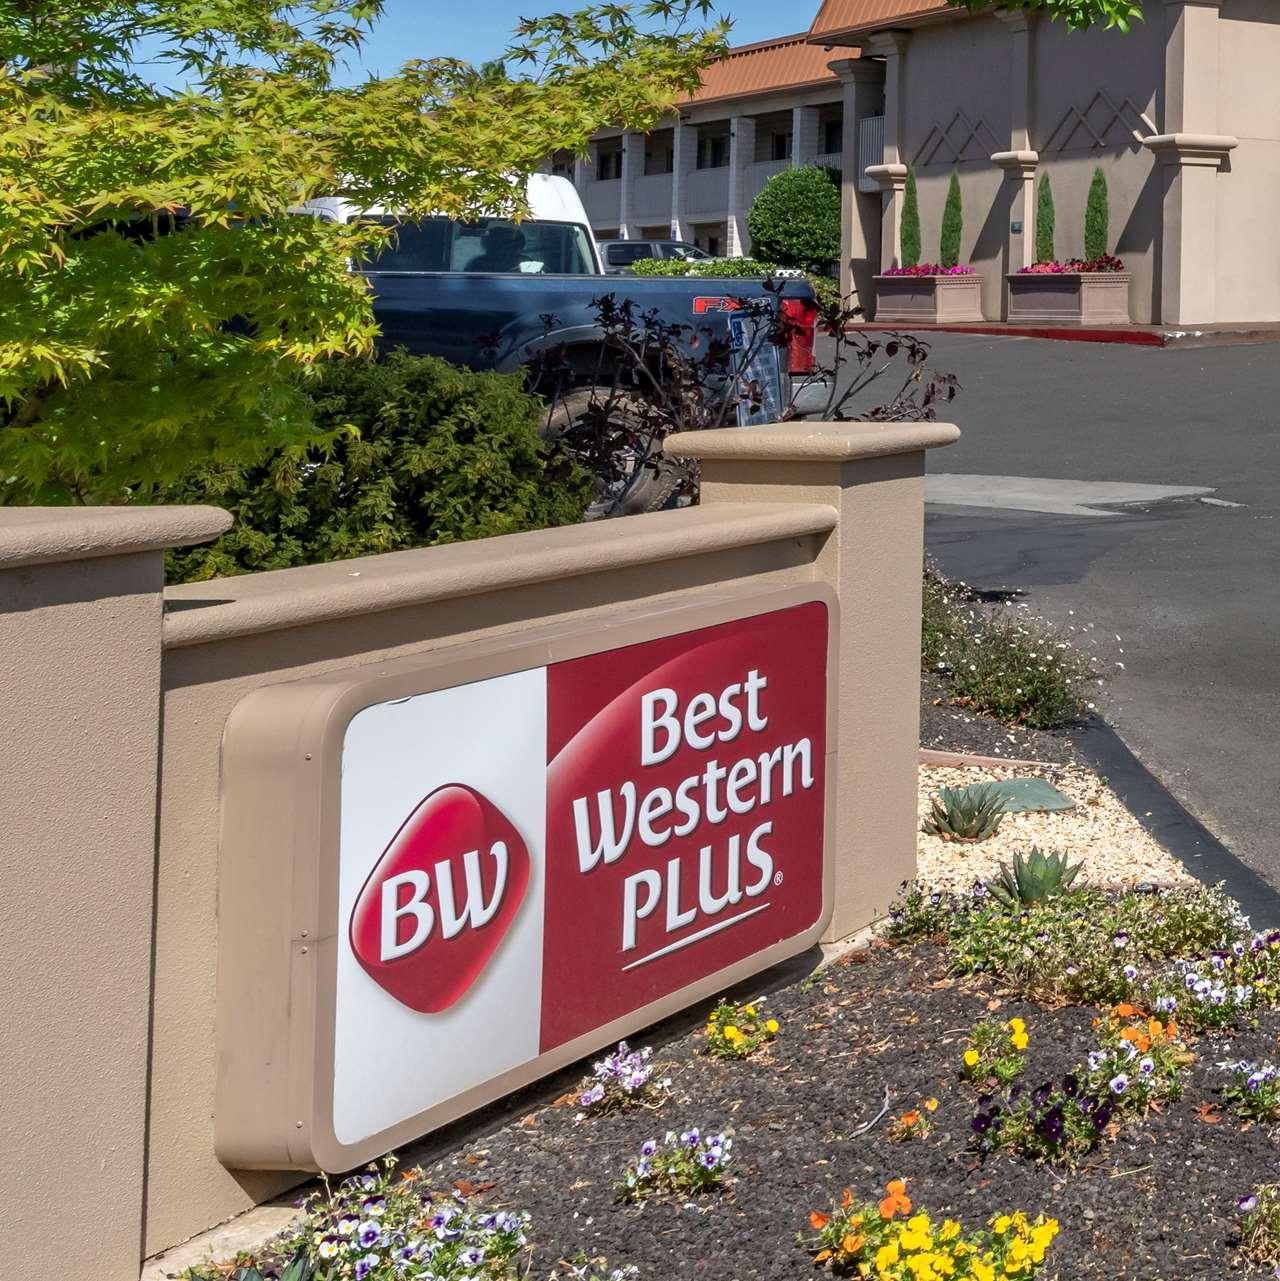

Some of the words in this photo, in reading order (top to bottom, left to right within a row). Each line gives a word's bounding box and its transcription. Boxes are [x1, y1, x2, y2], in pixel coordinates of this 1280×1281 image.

[640, 669, 768, 767] Best
[572, 737, 815, 873] Western
[379, 841, 509, 963] BW
